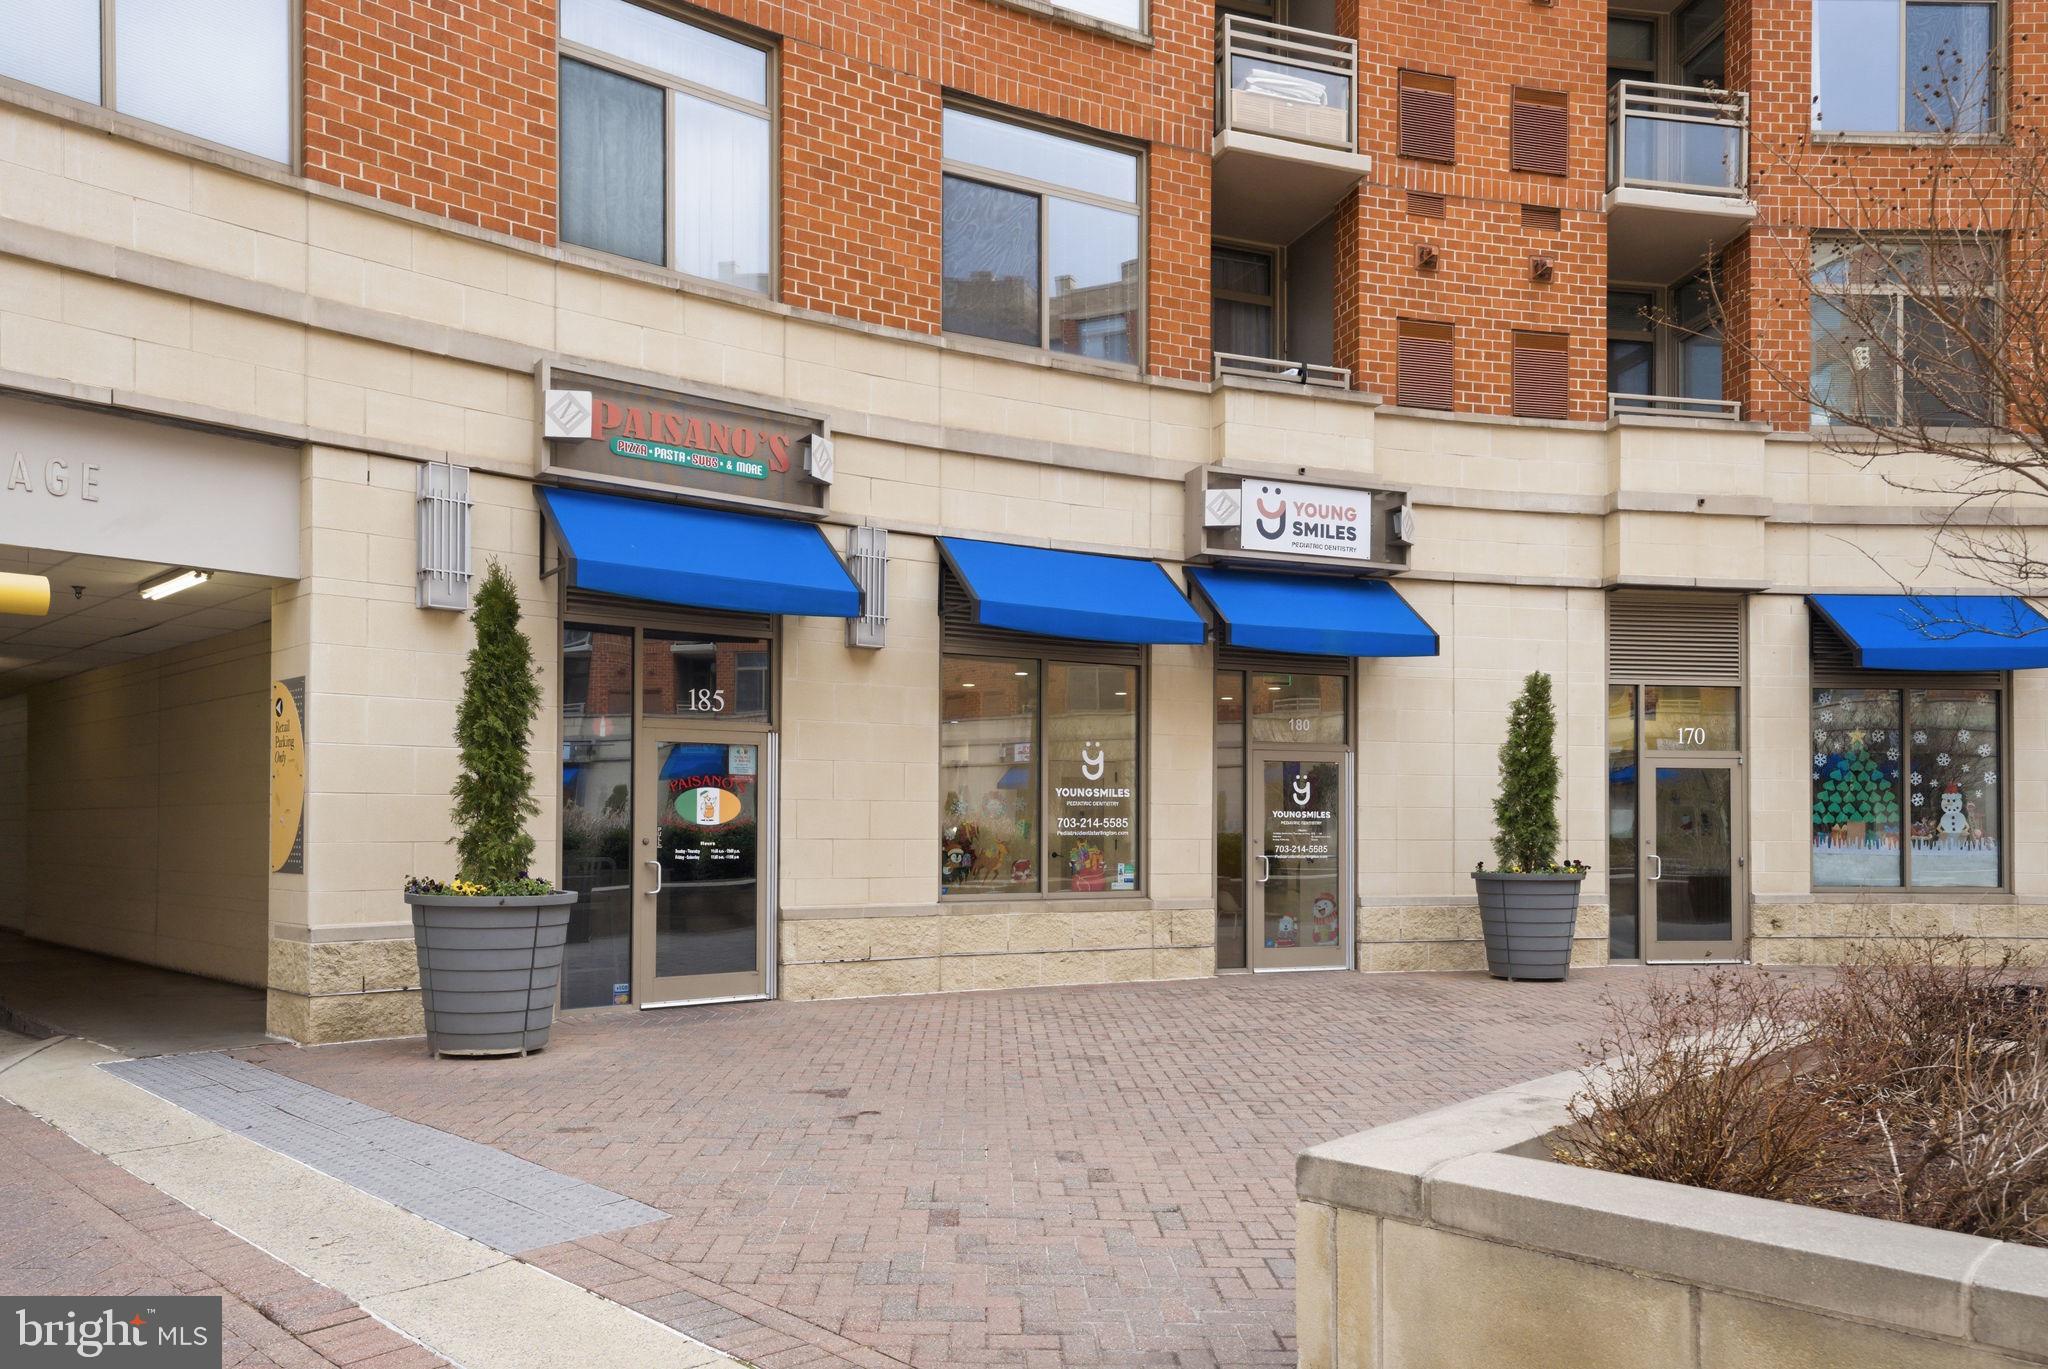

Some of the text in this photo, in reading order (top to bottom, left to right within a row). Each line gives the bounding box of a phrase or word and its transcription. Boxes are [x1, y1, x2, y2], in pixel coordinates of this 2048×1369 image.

[591, 399, 791, 474] PAISANO'S
[616, 440, 763, 476] PIZZA PASTA SUBS & MORE
[1293, 501, 1357, 522] YOUNG
[1292, 521, 1357, 542] SMILES
[688, 688, 725, 712] 185
[275, 720, 290, 733] Retail
[1288, 718, 1310, 731] 180
[275, 735, 295, 751] Parking
[1677, 727, 1706, 745] 170
[274, 751, 287, 767] Only
[1055, 787, 1131, 798] YOUNGSMILES
[1057, 817, 1129, 828] 703-214-5585
[1272, 810, 1331, 819] YOUNGSMILES
